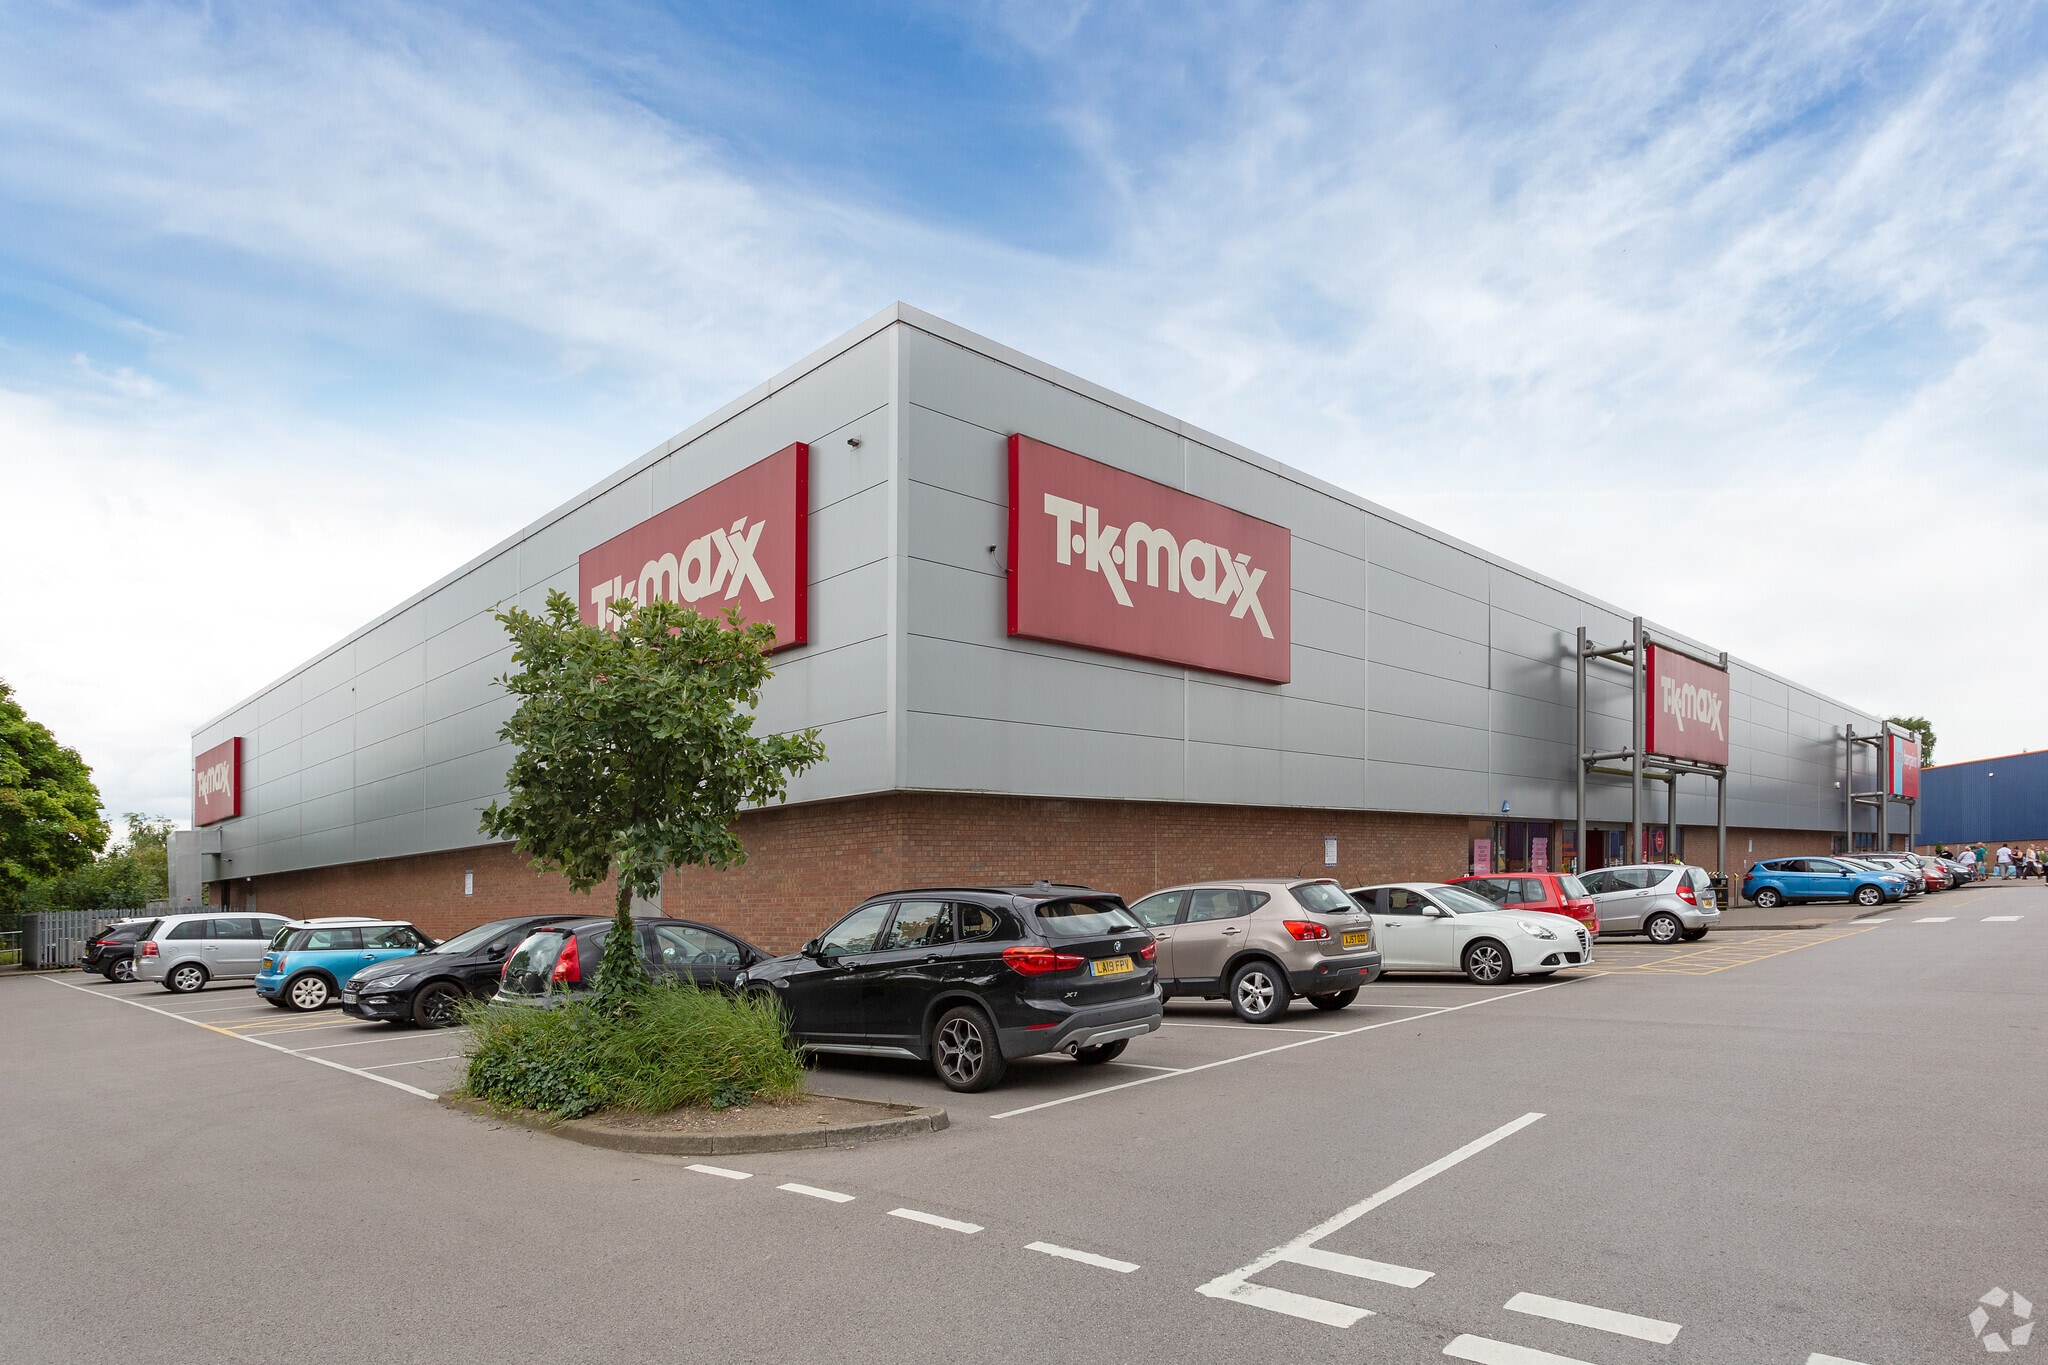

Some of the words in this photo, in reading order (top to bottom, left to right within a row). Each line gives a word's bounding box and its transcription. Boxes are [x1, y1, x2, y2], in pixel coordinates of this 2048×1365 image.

[1096, 960, 1115, 974] LA19
[1115, 959, 1129, 971] FPV
[1064, 991, 1078, 999] X1
